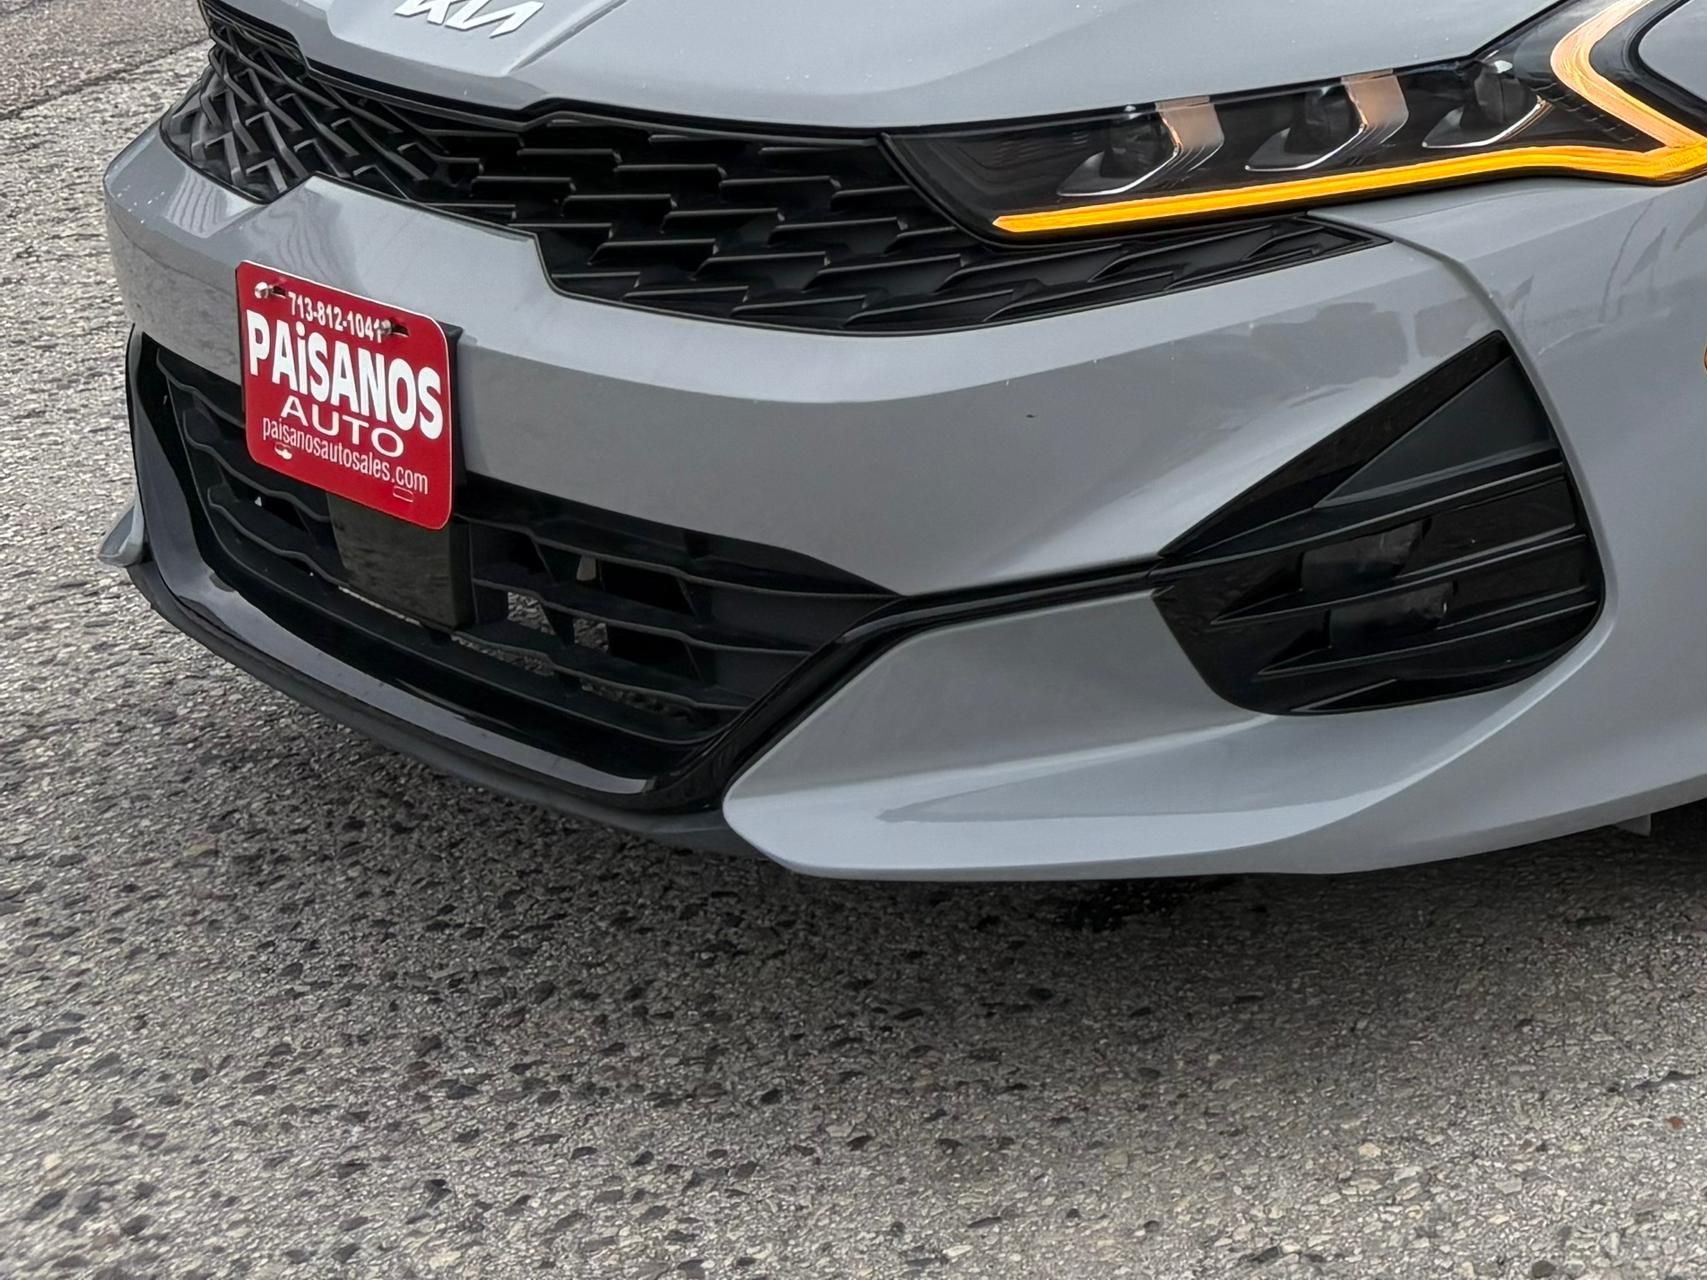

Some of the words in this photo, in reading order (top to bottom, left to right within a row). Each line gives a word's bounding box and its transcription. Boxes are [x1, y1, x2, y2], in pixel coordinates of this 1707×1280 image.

[287, 290, 384, 344] 713-812-1041
[262, 416, 429, 496] paisanosautosales.com
[280, 395, 405, 459] AUTO
